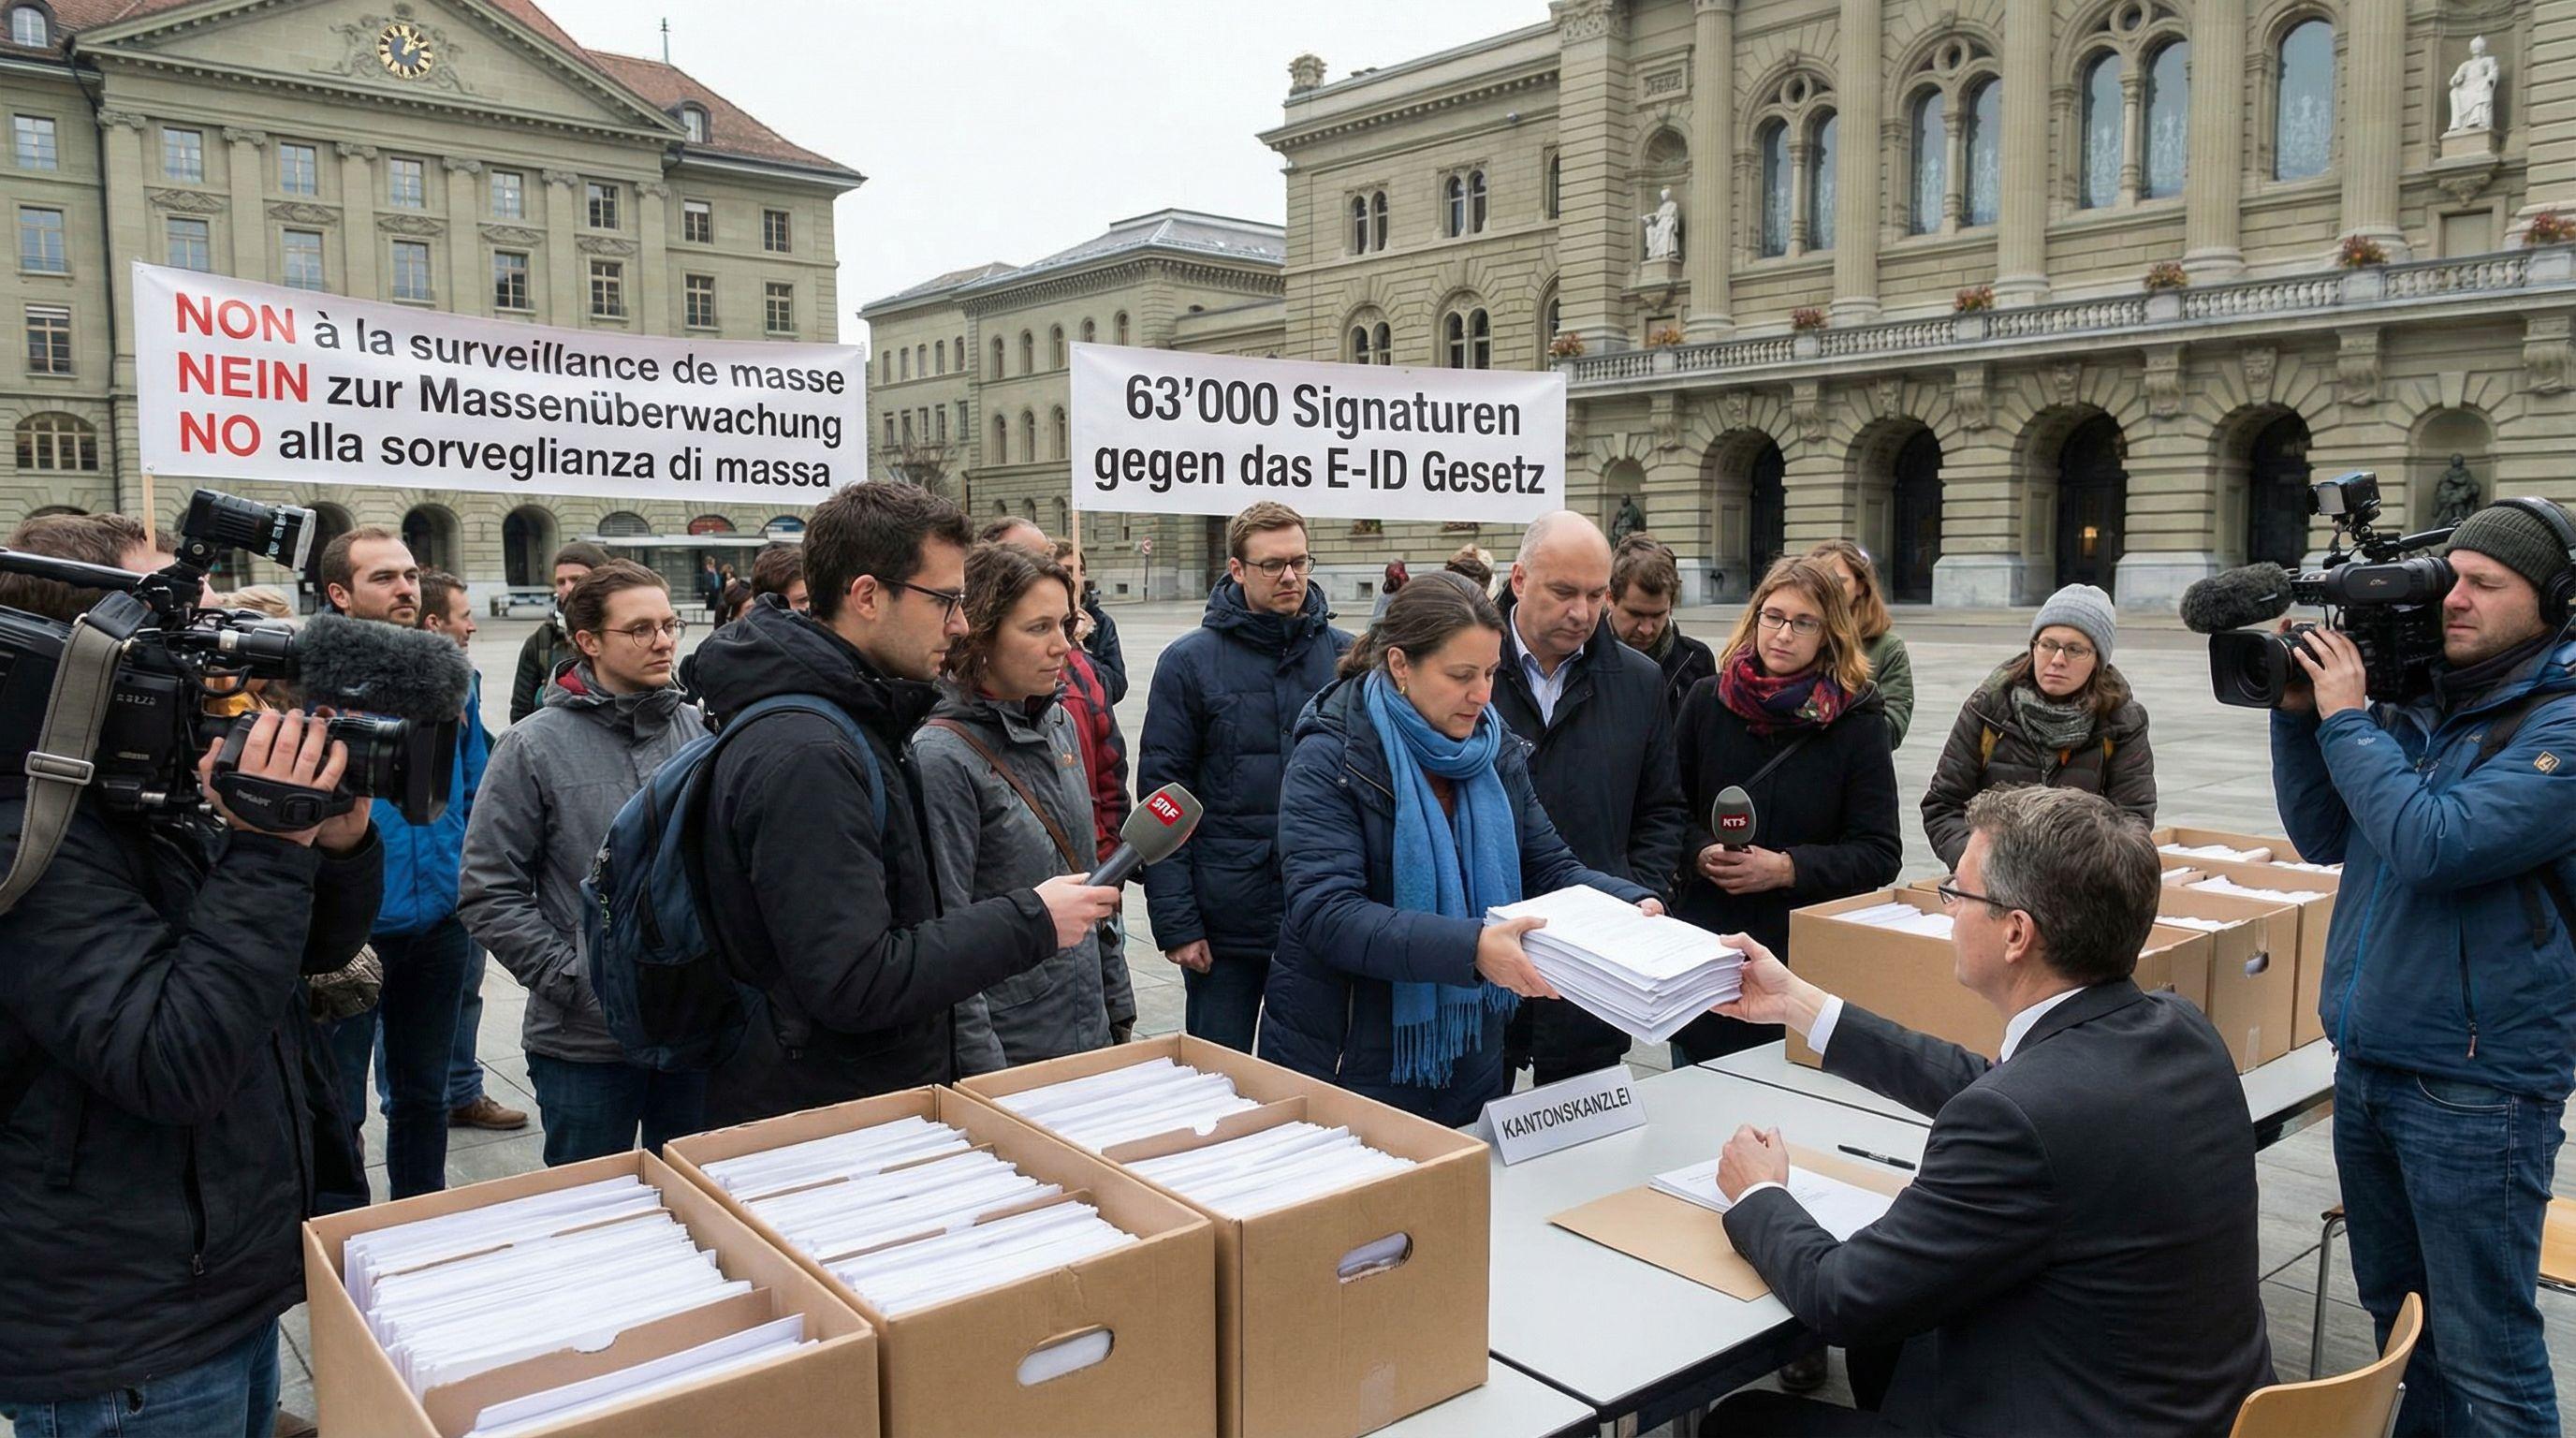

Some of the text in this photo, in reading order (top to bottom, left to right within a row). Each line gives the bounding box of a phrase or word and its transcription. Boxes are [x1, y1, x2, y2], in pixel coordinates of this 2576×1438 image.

[175, 292, 845, 395] NON à la surveillance de masse
[177, 351, 842, 449] NEIN zur Massenüberwachung
[1293, 383, 1521, 440] Signaturen
[180, 411, 831, 488] NO alla sorveglianza di massa
[1094, 444, 1545, 494] gegen das E-ID Gesetz
[1501, 1086, 1632, 1140] KANTONSKANZLEI
